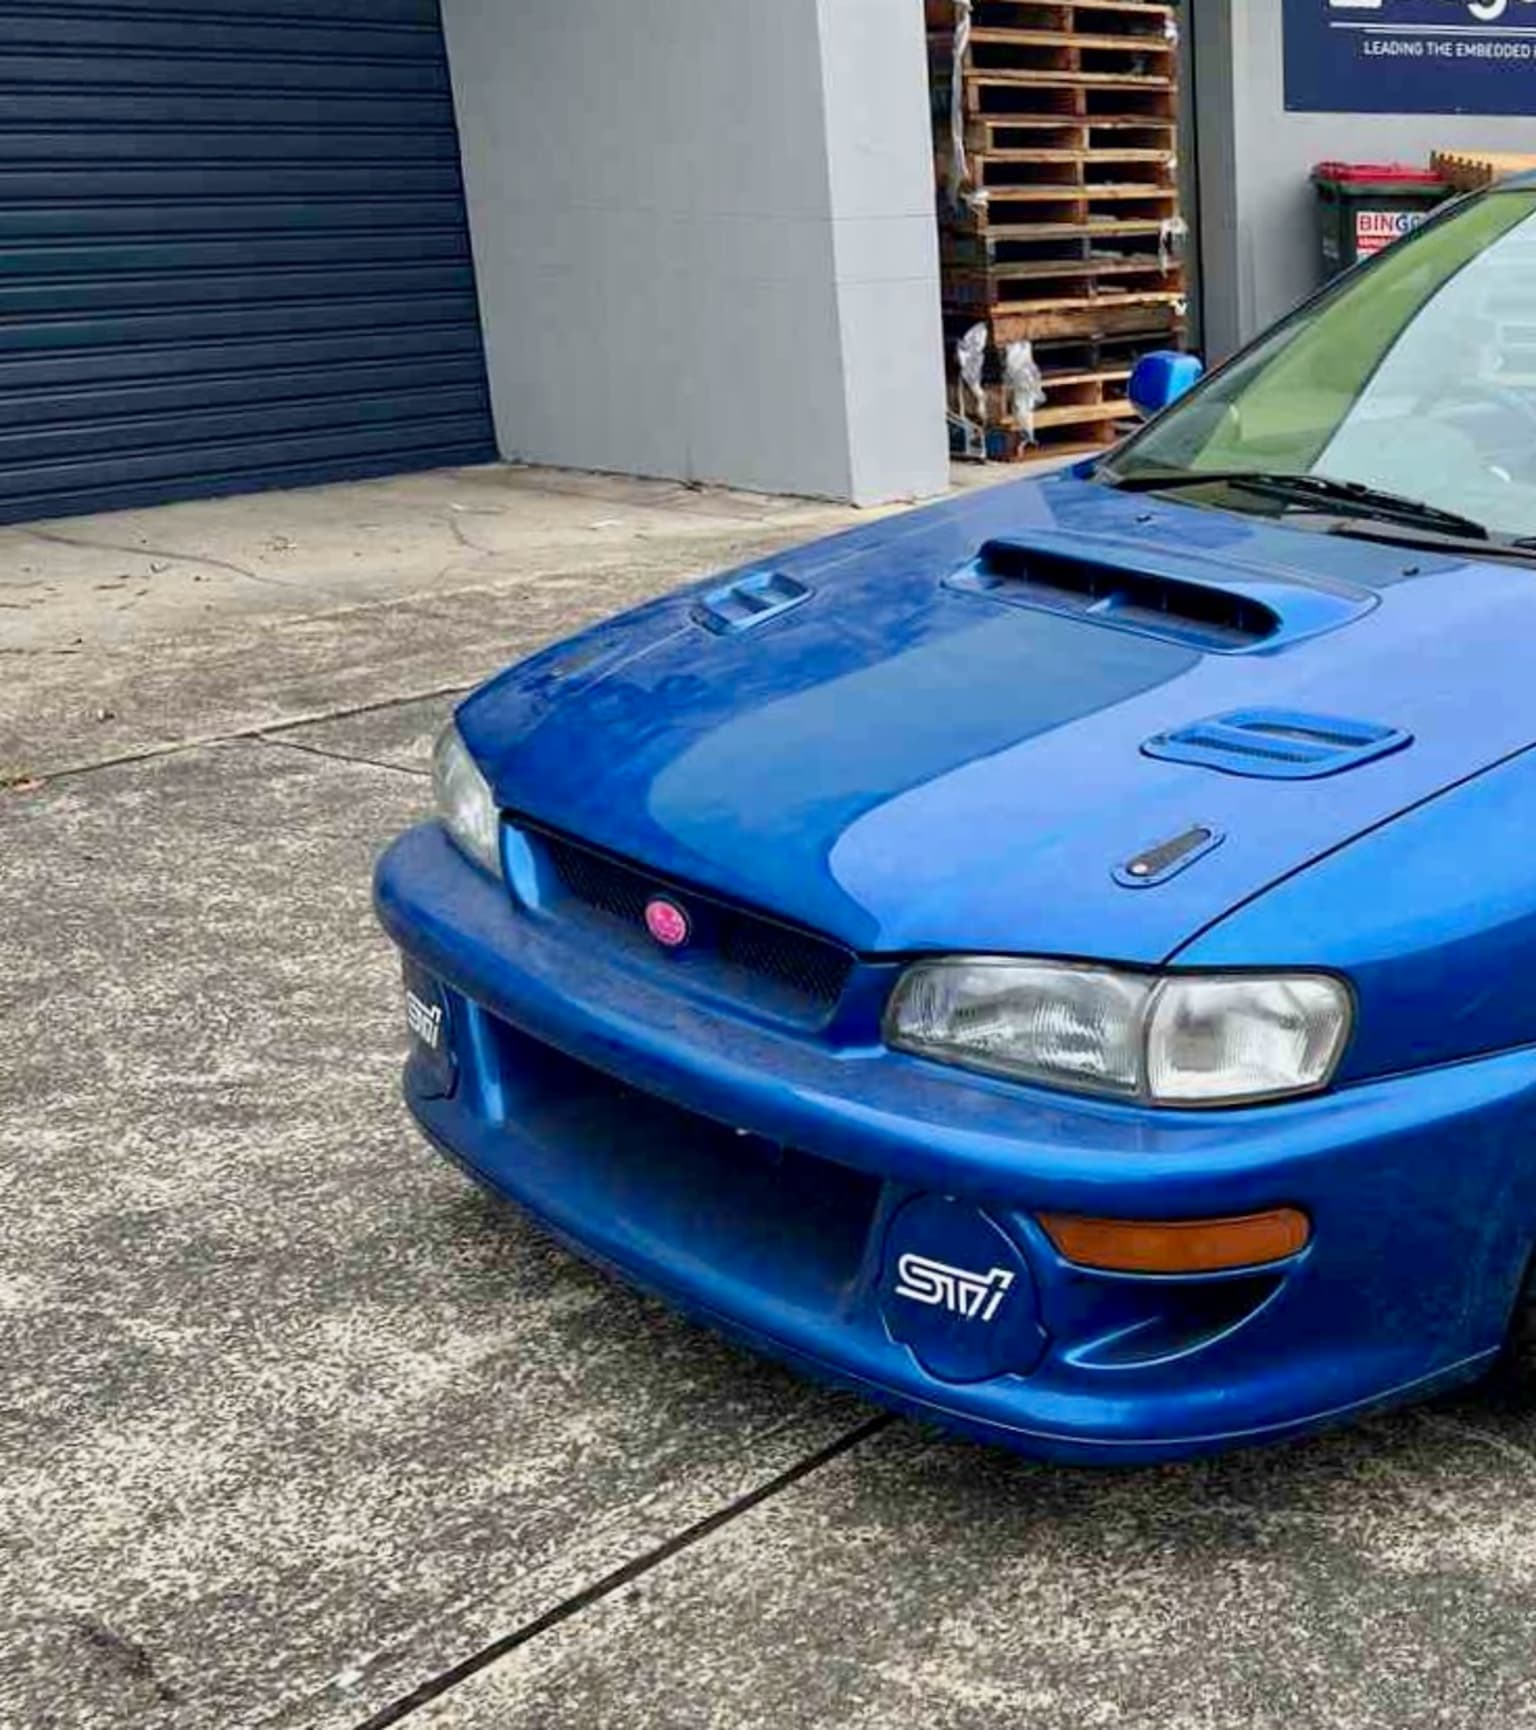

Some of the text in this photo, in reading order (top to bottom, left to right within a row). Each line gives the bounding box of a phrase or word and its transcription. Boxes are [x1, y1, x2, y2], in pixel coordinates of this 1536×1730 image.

[1363, 40, 1423, 56] LEADING
[1426, 41, 1453, 57] THE
[1455, 42, 1531, 59] EMBEDDED
